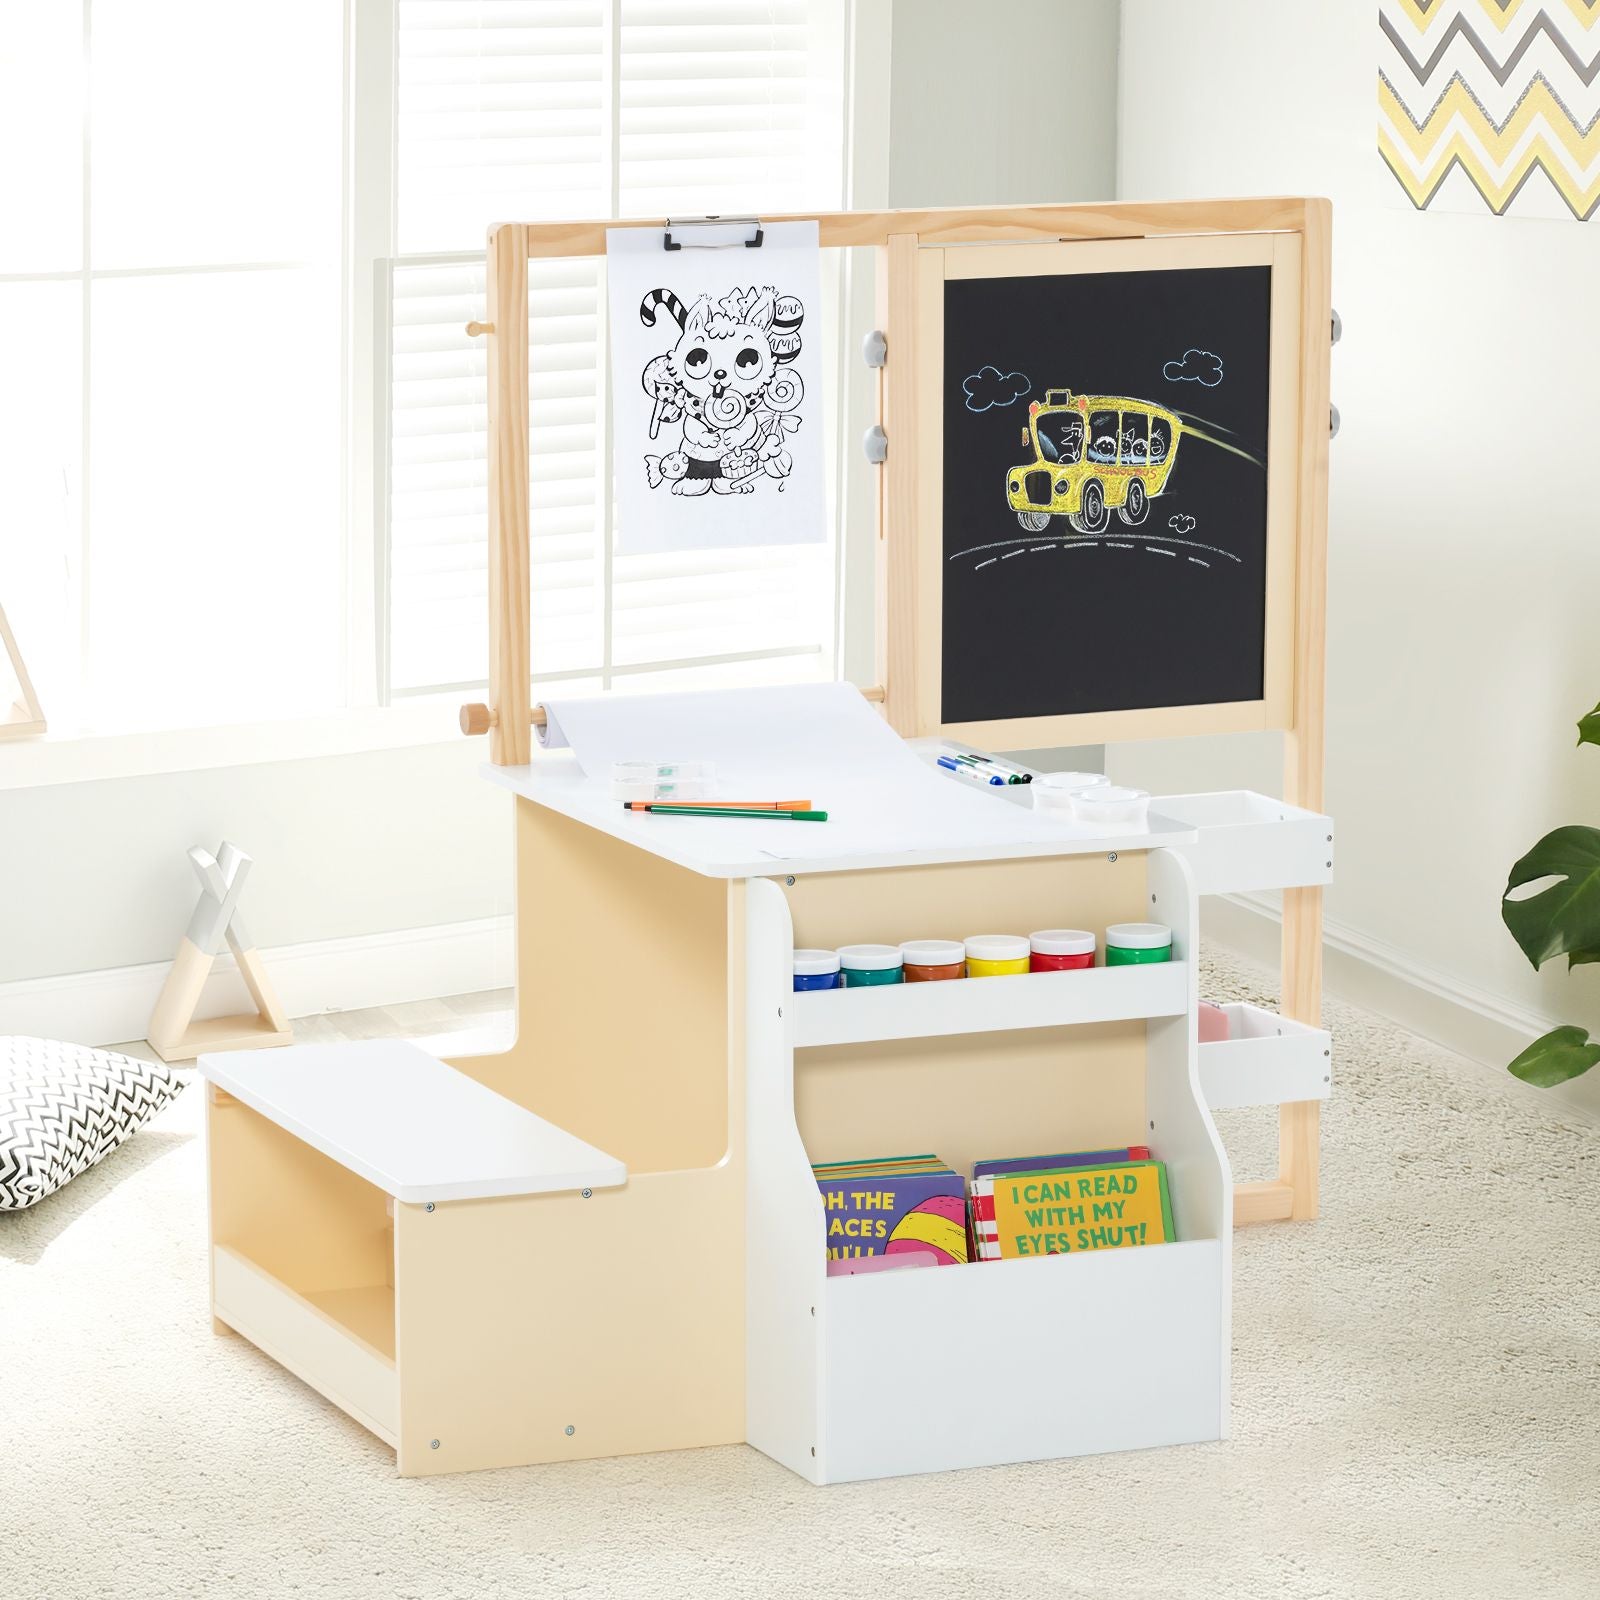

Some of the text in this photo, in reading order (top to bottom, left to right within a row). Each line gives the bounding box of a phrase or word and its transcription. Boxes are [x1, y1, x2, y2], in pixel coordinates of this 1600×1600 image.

[1134, 468, 1157, 479] BUS
[823, 1191, 895, 1211] H, THE
[1012, 1175, 1138, 1204] I CAN READ
[1025, 1200, 1126, 1228] WITH MY
[1015, 1222, 1147, 1255] EYES SHUT!
